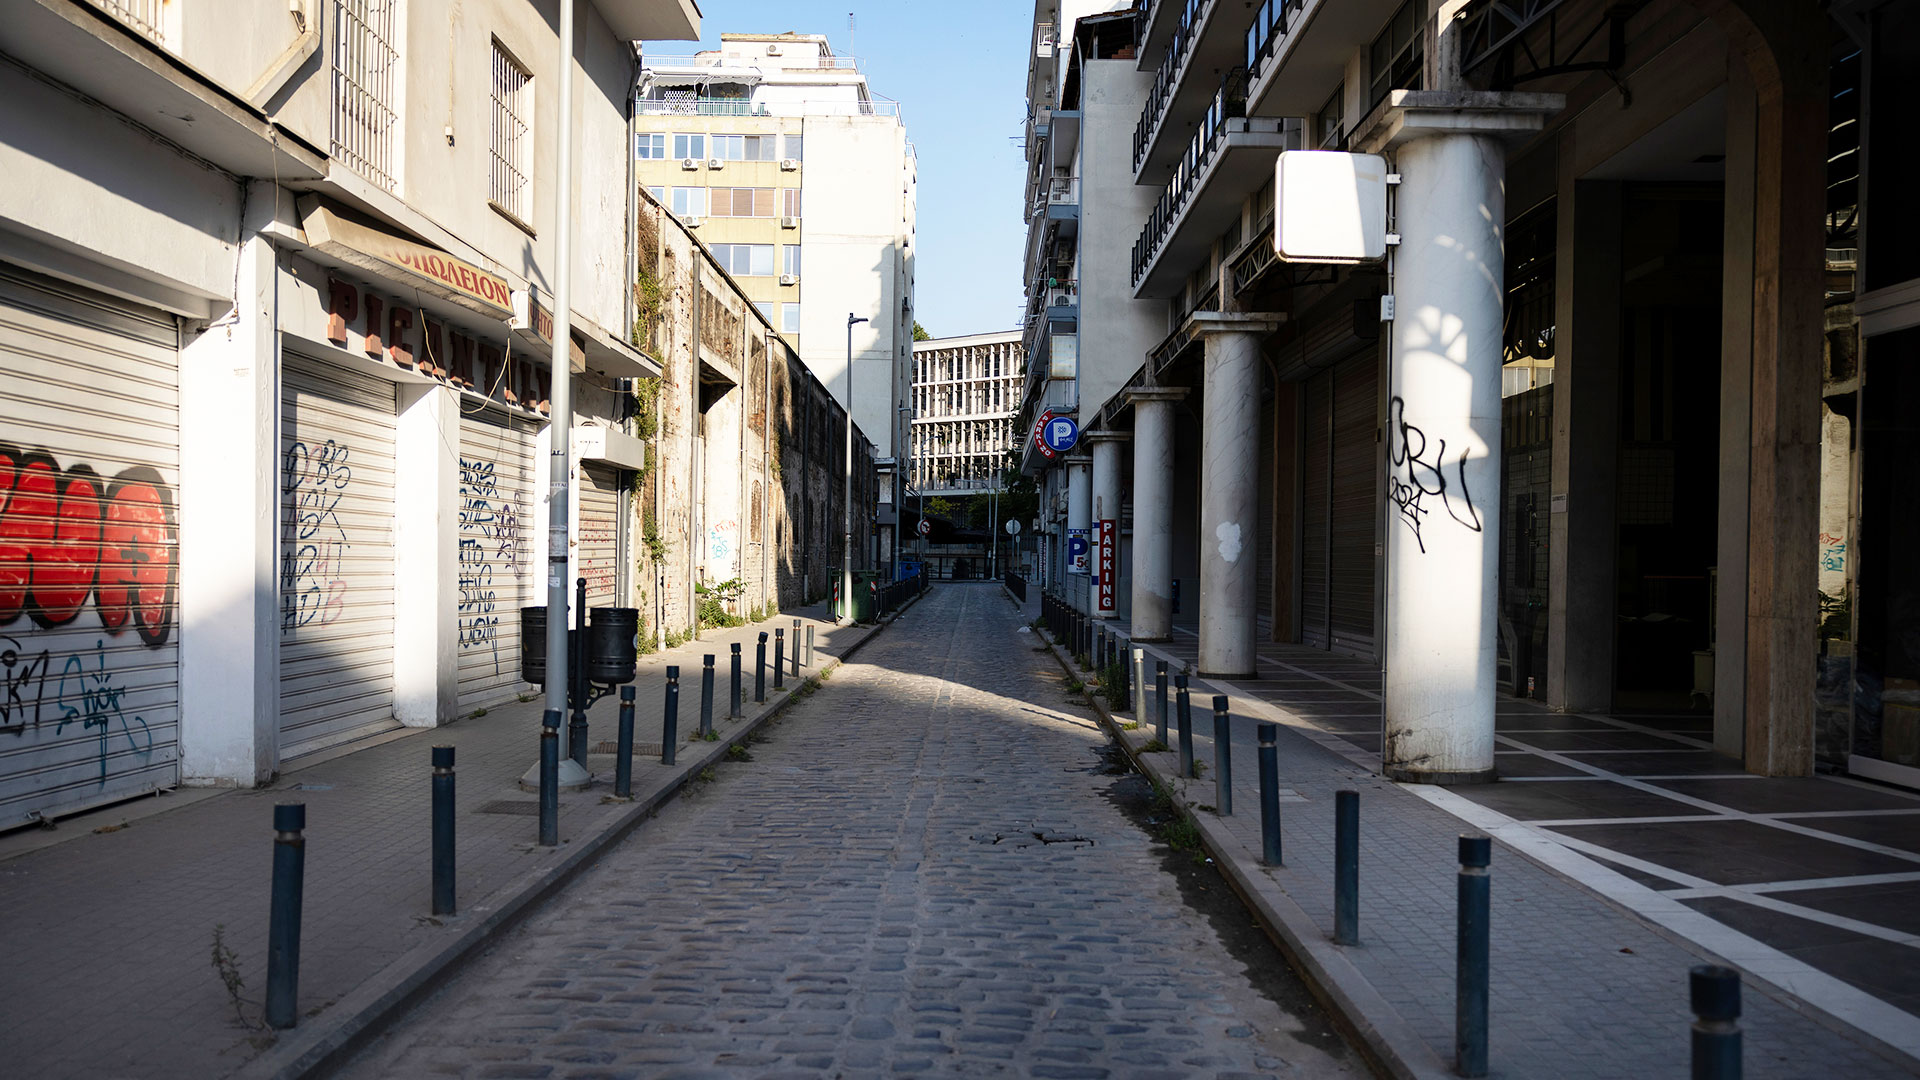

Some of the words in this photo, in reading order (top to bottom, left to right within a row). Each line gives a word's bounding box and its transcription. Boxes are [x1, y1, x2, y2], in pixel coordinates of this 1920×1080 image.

[1035, 415, 1052, 456] PARKING
[1053, 422, 1072, 447] P
[1102, 522, 1112, 607] PARKING
